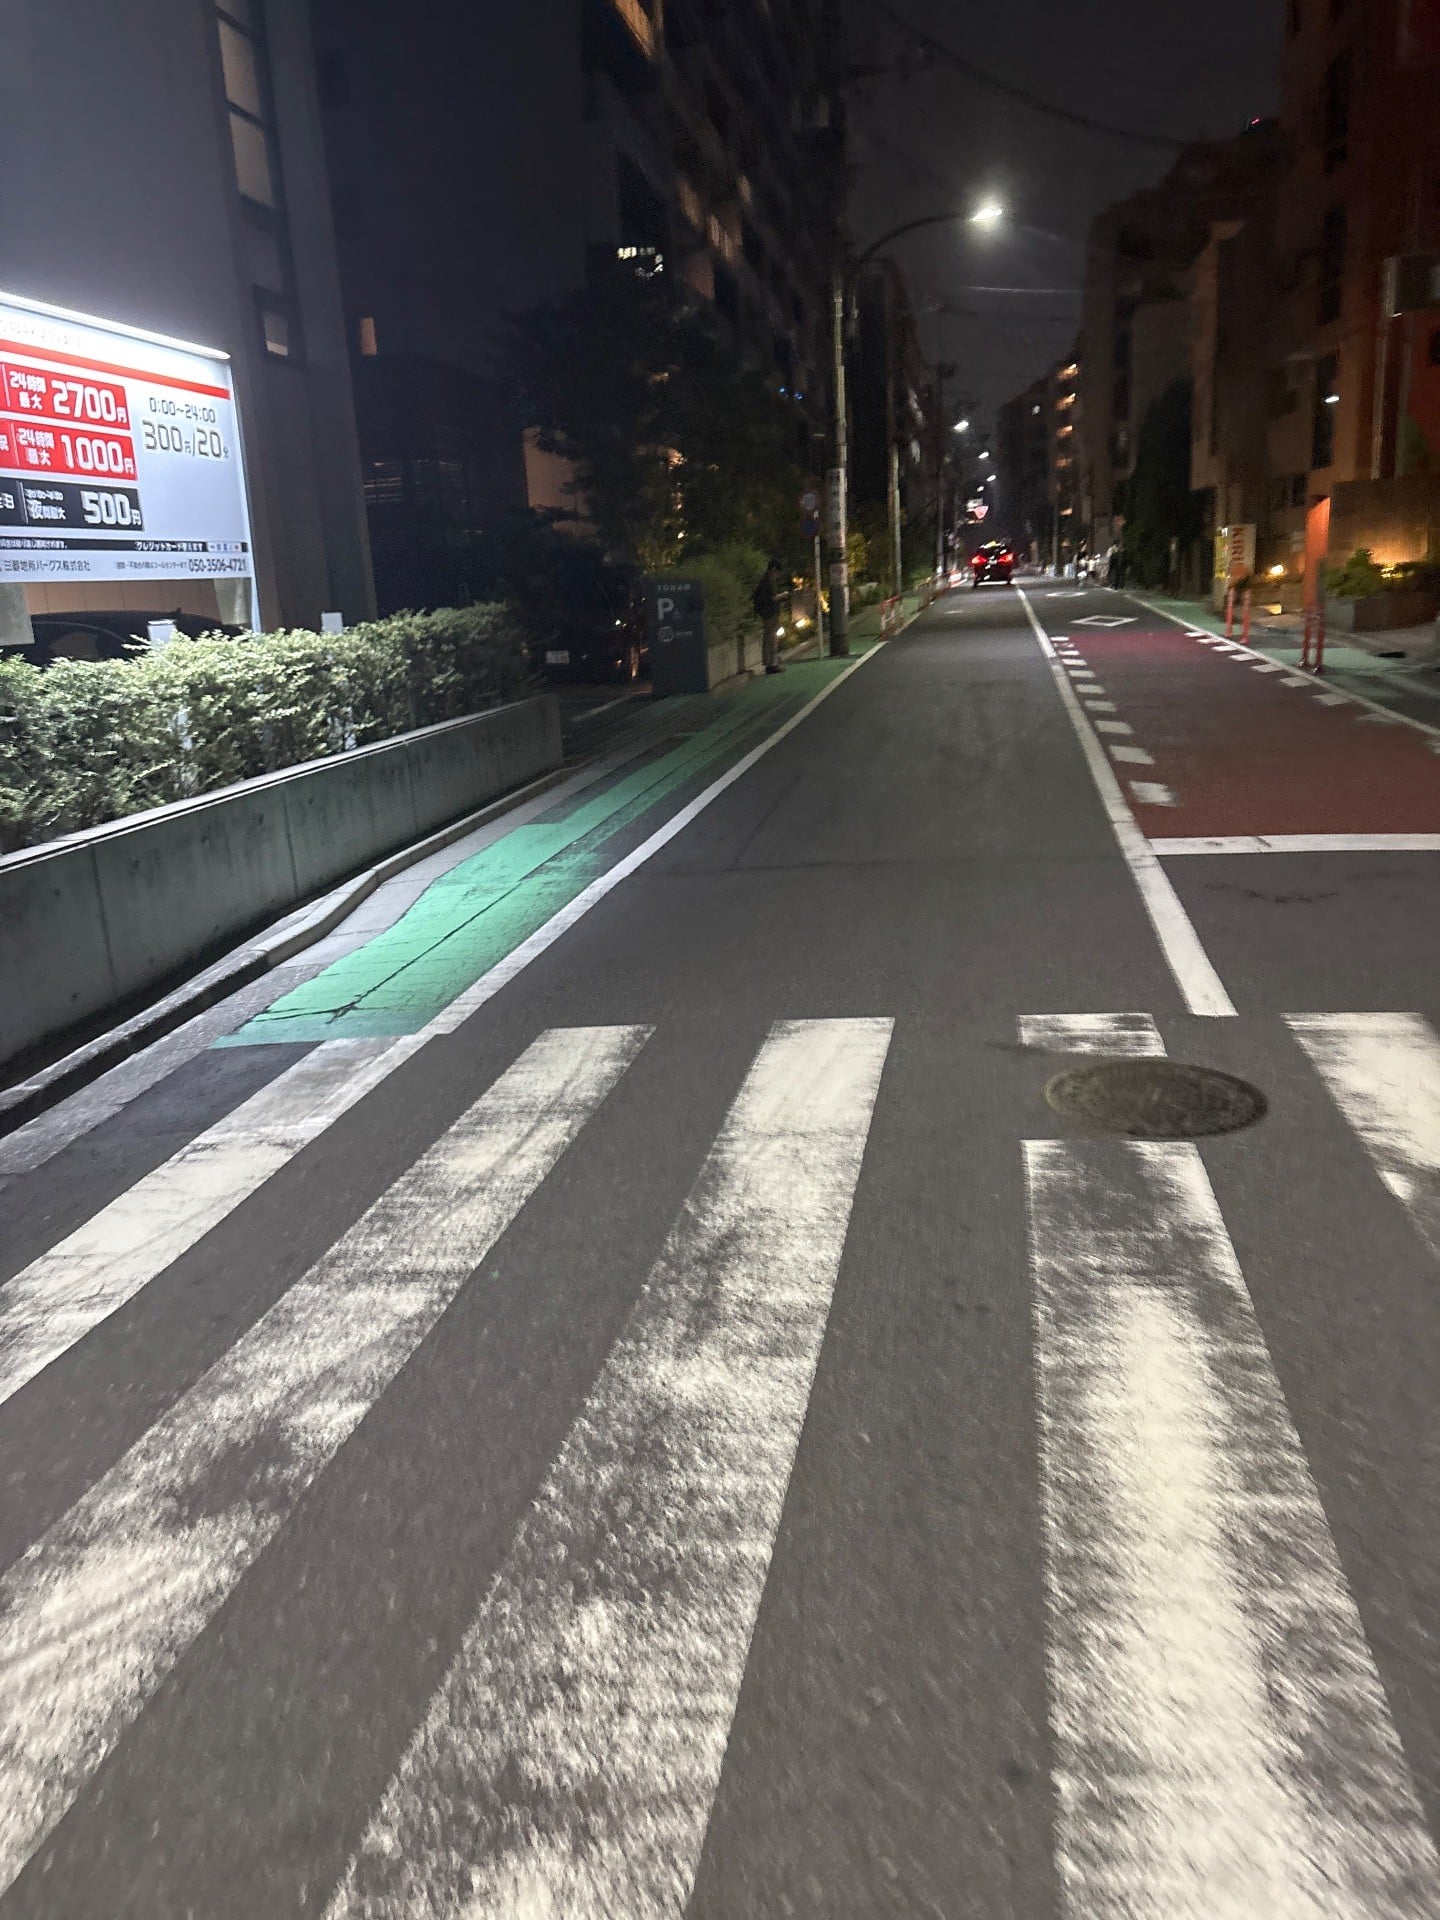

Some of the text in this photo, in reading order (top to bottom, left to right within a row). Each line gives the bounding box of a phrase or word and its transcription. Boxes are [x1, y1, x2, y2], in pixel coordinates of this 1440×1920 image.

[51, 379, 128, 423] 2700円
[61, 434, 134, 474] 1000円
[80, 490, 142, 526] 500円
[657, 597, 675, 621] P
